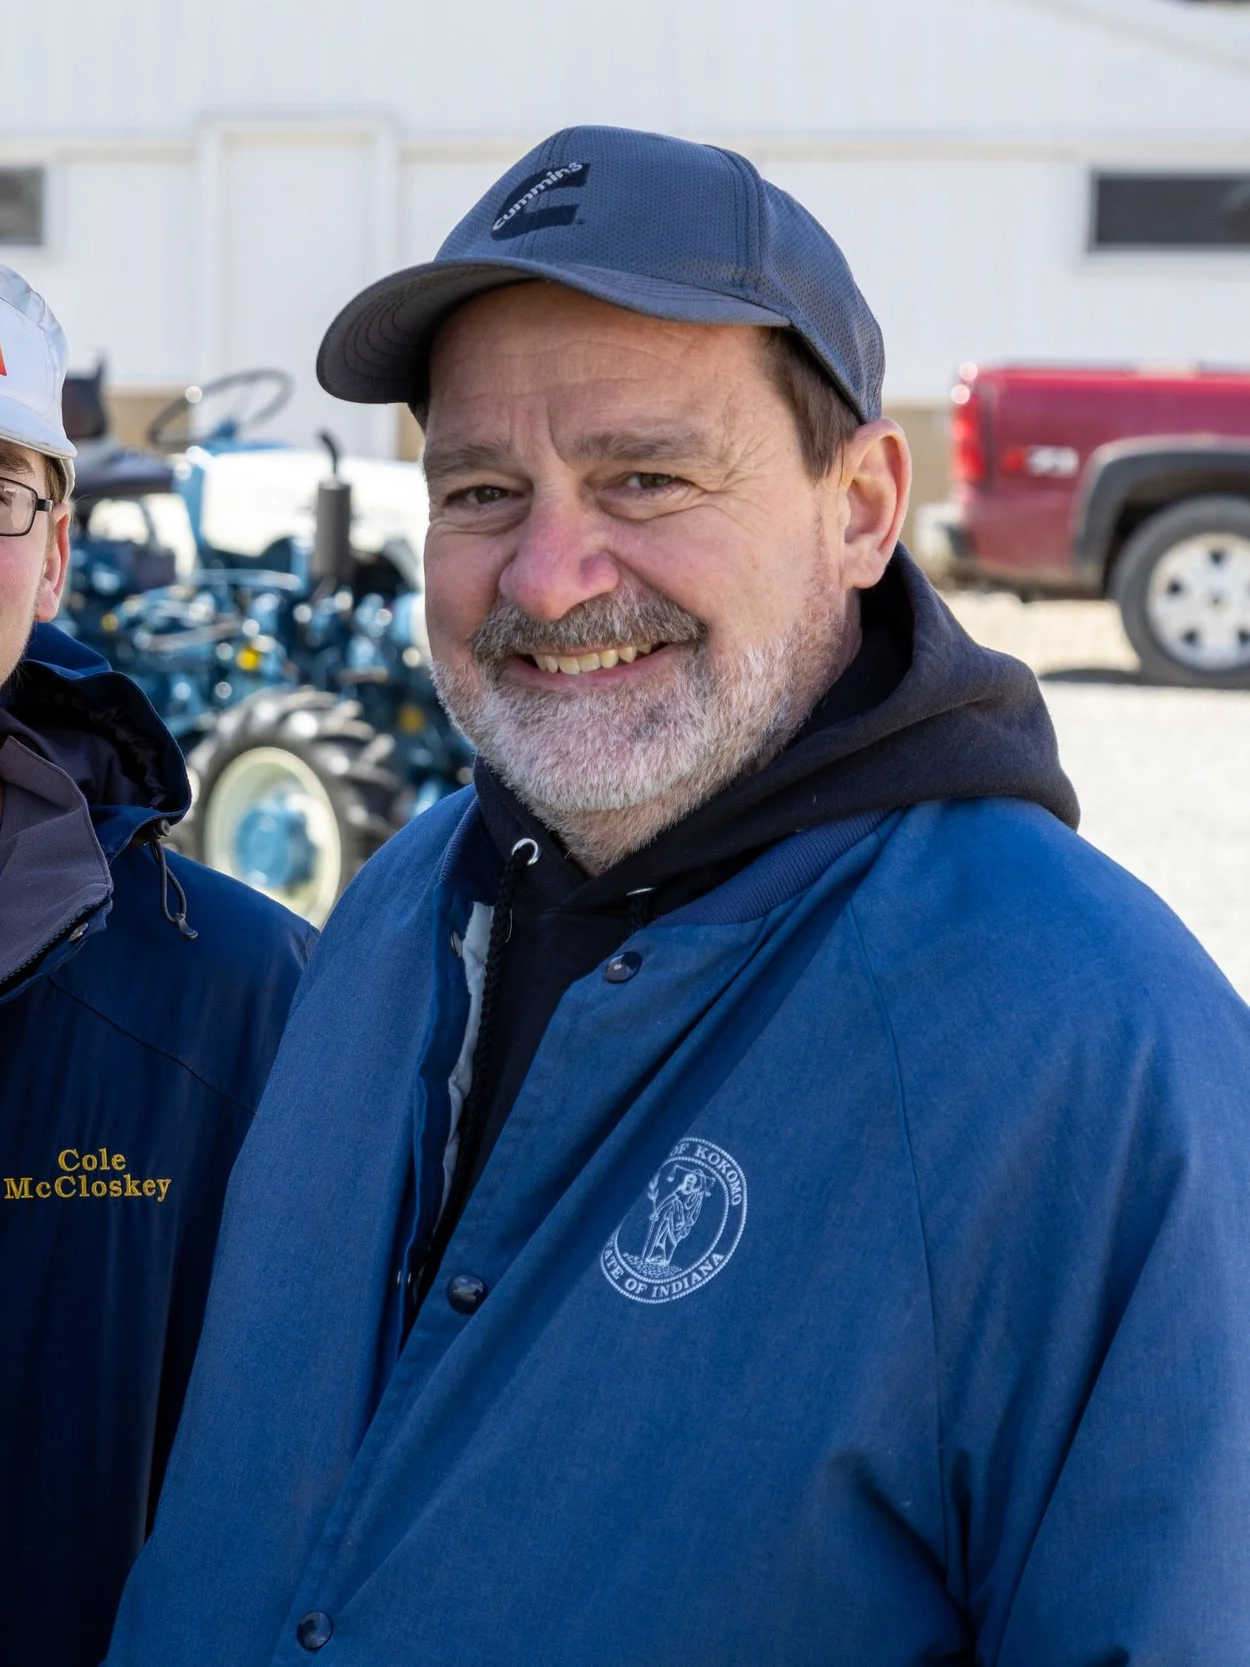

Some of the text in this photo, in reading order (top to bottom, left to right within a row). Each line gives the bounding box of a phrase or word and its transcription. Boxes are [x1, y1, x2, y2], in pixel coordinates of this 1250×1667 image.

[57, 1147, 126, 1172] Cole
[694, 1144, 743, 1206] KOKOMO
[3, 1173, 172, 1202] McCloskey
[625, 1278, 648, 1294] OF
[651, 1252, 725, 1298] INDIANA
